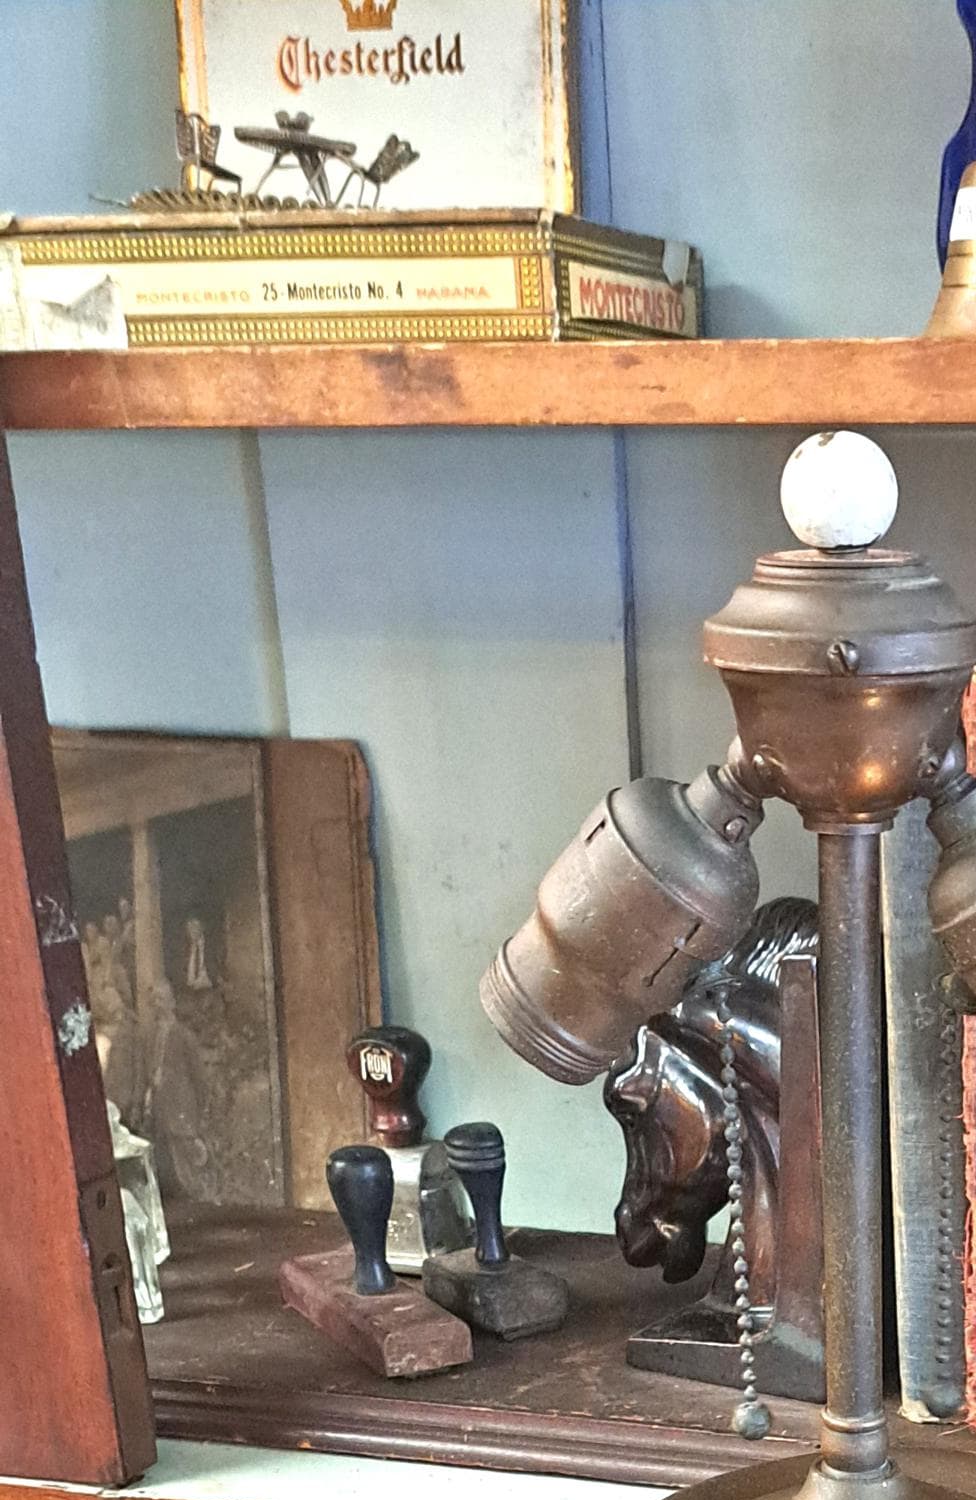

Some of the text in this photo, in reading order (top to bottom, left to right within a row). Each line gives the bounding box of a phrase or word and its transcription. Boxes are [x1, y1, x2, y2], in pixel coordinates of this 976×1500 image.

[279, 32, 465, 94] Chesterfield
[287, 282, 362, 301] Montecristo
[367, 281, 389, 299] No.
[395, 280, 404, 298] 4
[416, 286, 491, 300] HABANA
[579, 276, 686, 331] MONTECRISTO
